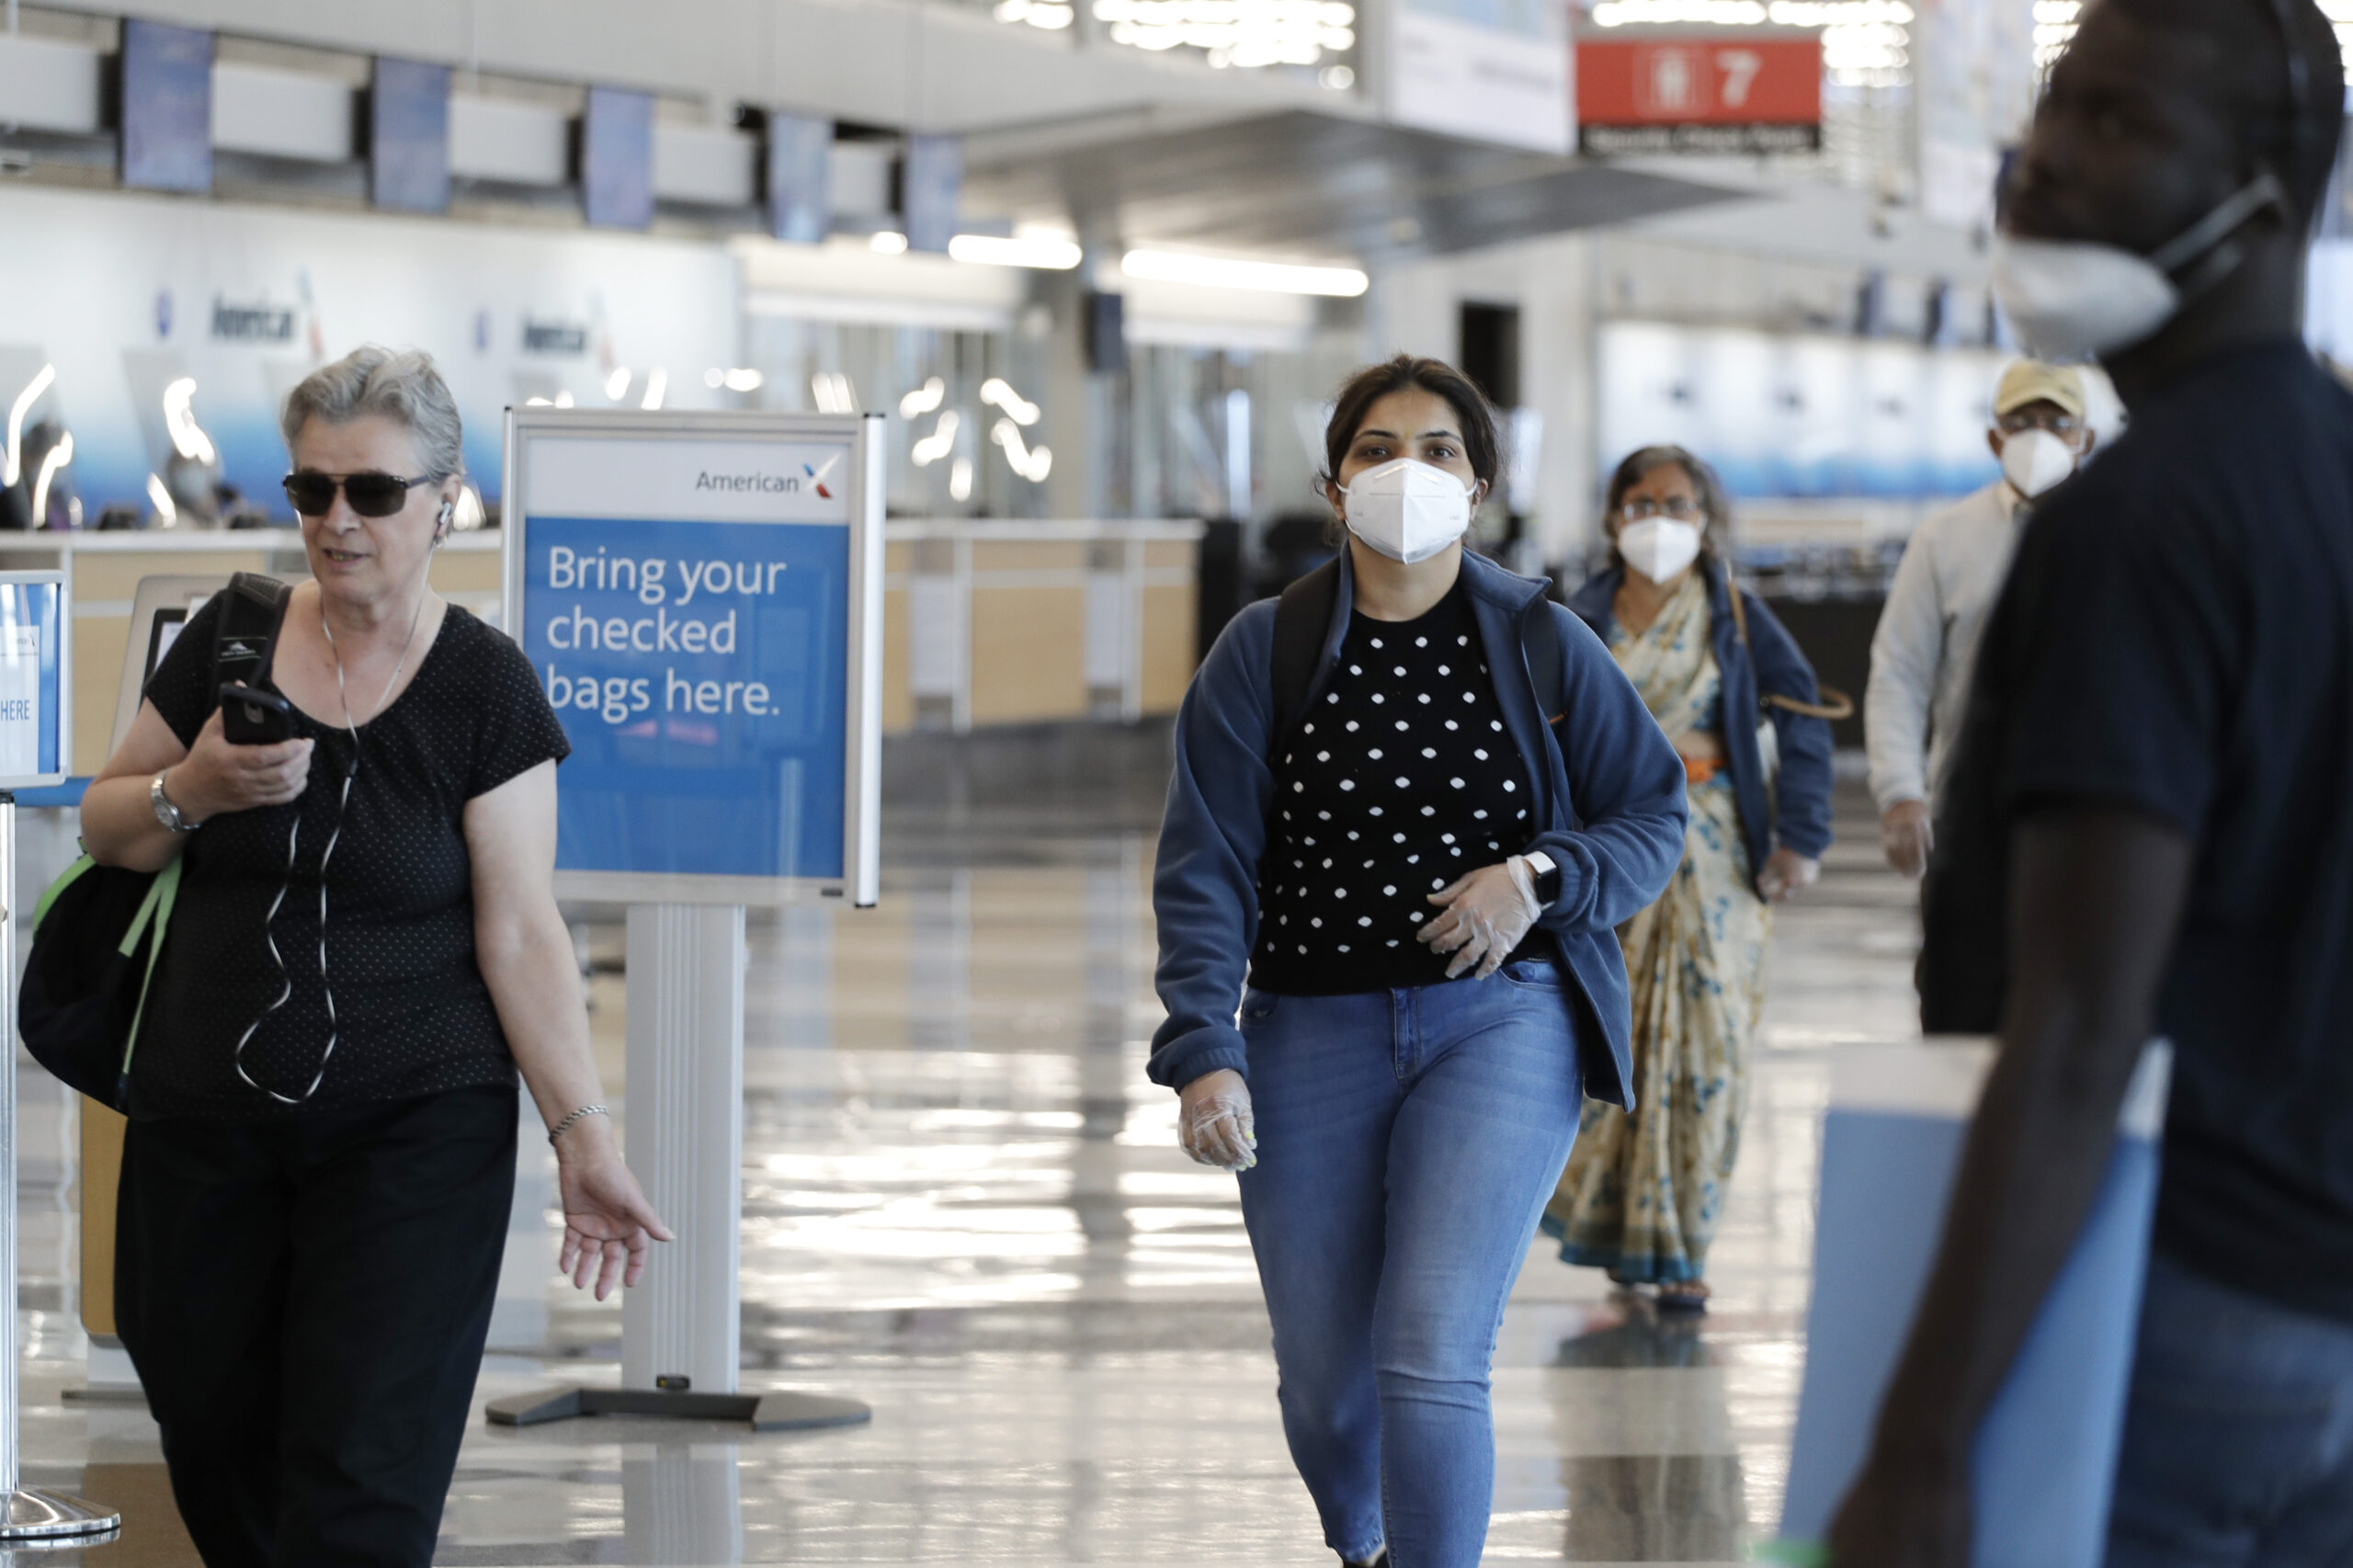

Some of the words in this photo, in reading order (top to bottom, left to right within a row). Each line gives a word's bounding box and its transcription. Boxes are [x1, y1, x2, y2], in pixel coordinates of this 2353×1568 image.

[1714, 49, 1762, 108] 7
[695, 471, 800, 494] American
[549, 546, 667, 606] Bring
[675, 561, 788, 607] your
[546, 605, 737, 654] checked
[0, 699, 30, 721] HERE
[547, 664, 652, 724] bags
[665, 667, 780, 716] here.
